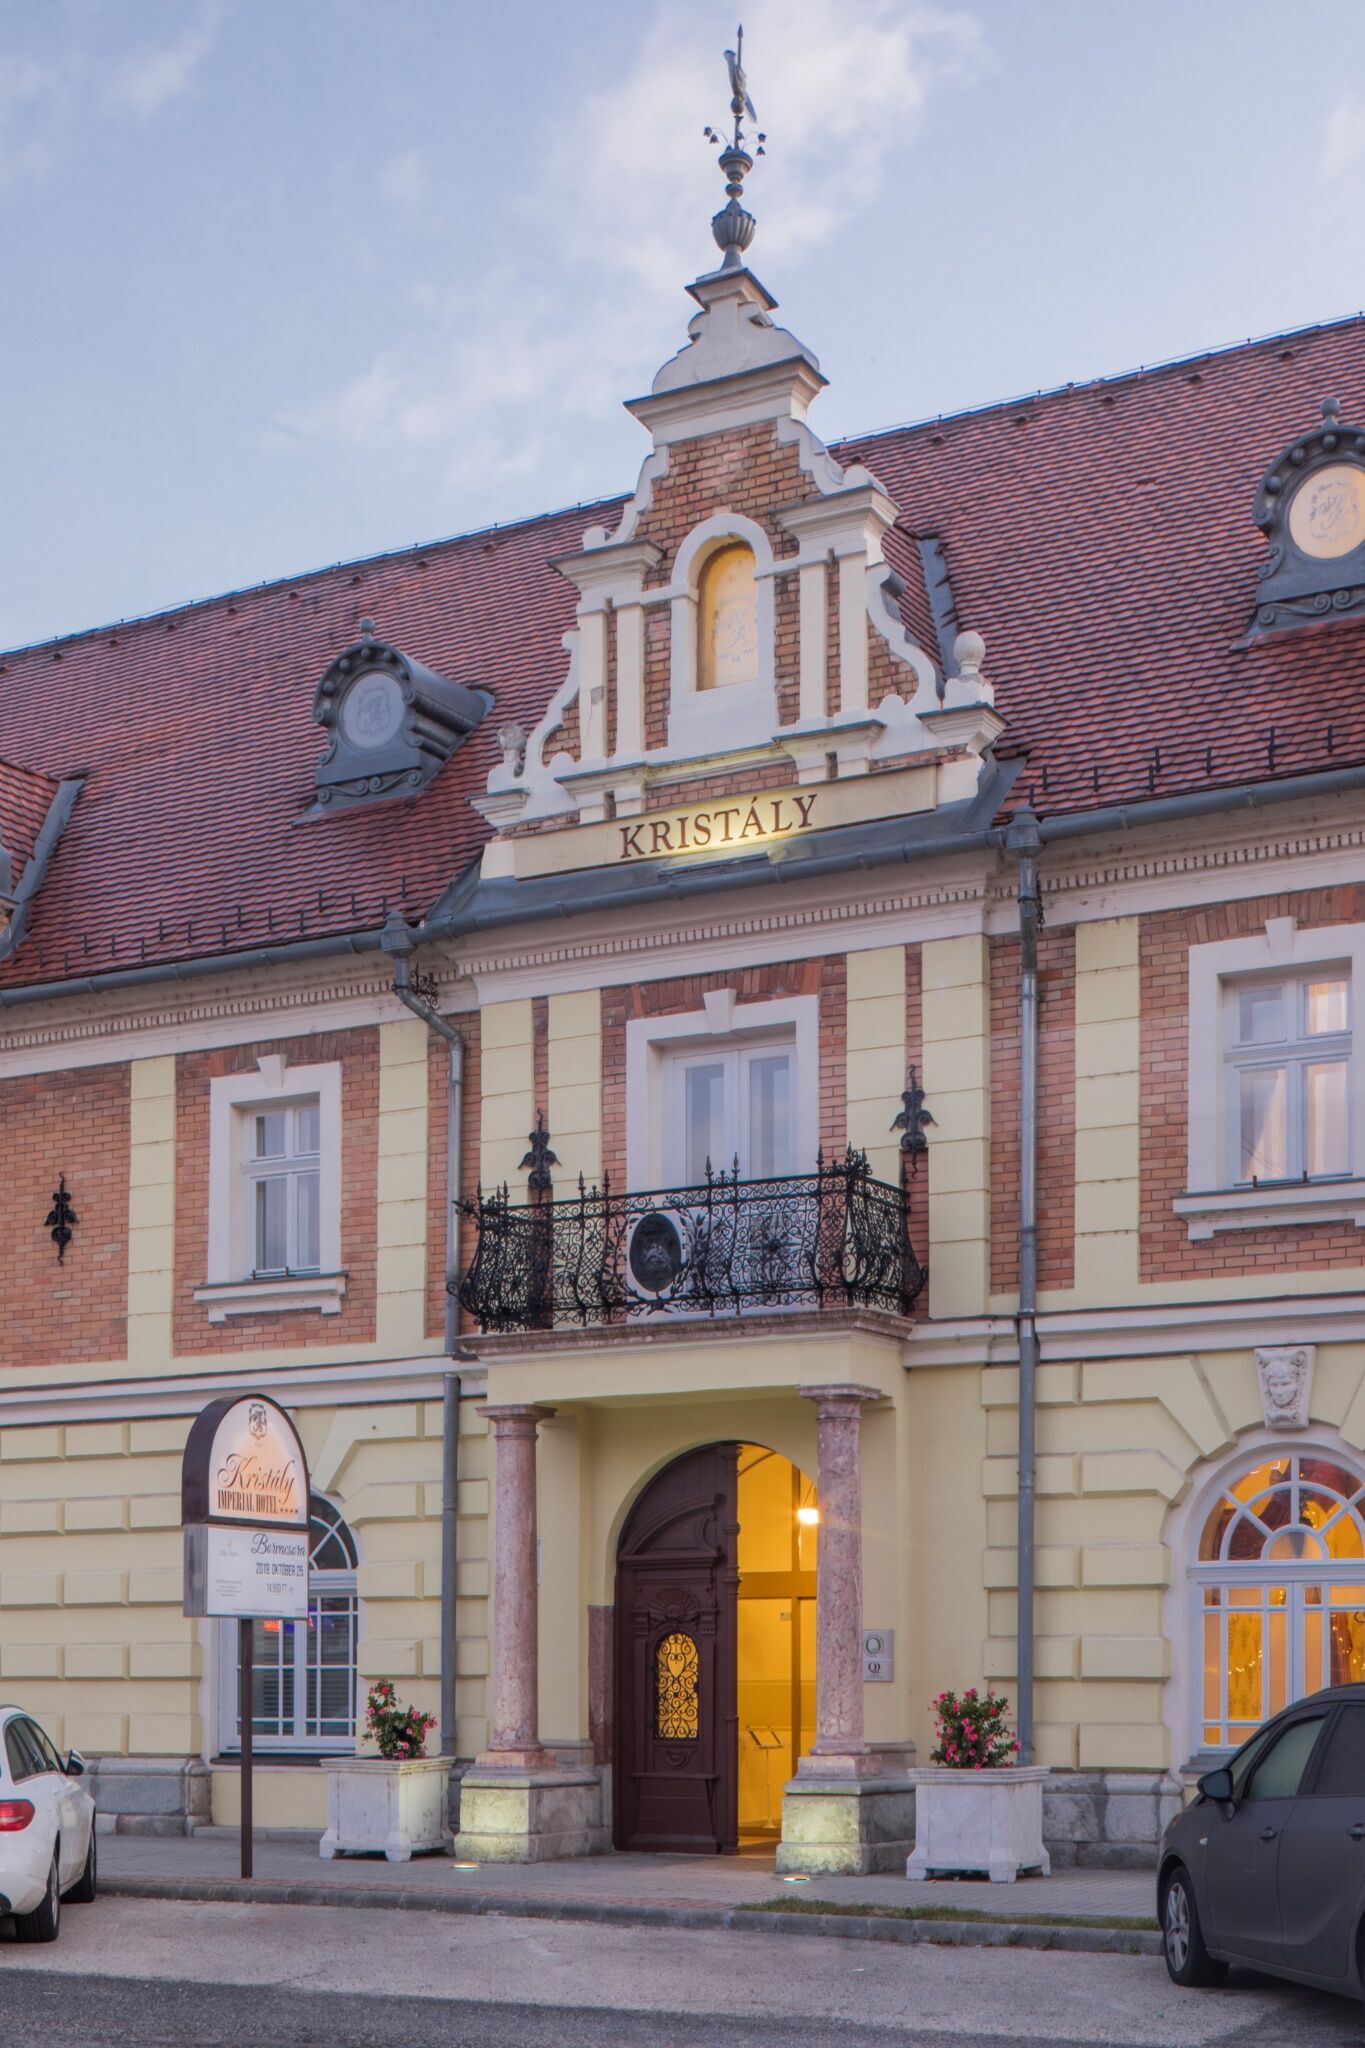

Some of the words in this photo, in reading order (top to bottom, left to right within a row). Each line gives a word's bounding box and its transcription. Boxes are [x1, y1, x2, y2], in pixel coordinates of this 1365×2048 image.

[619, 794, 818, 858] KRISTÁLY
[217, 1453, 295, 1504] Kristály
[218, 1490, 254, 1512] IMPERIAL
[256, 1493, 278, 1514] HOTEL
